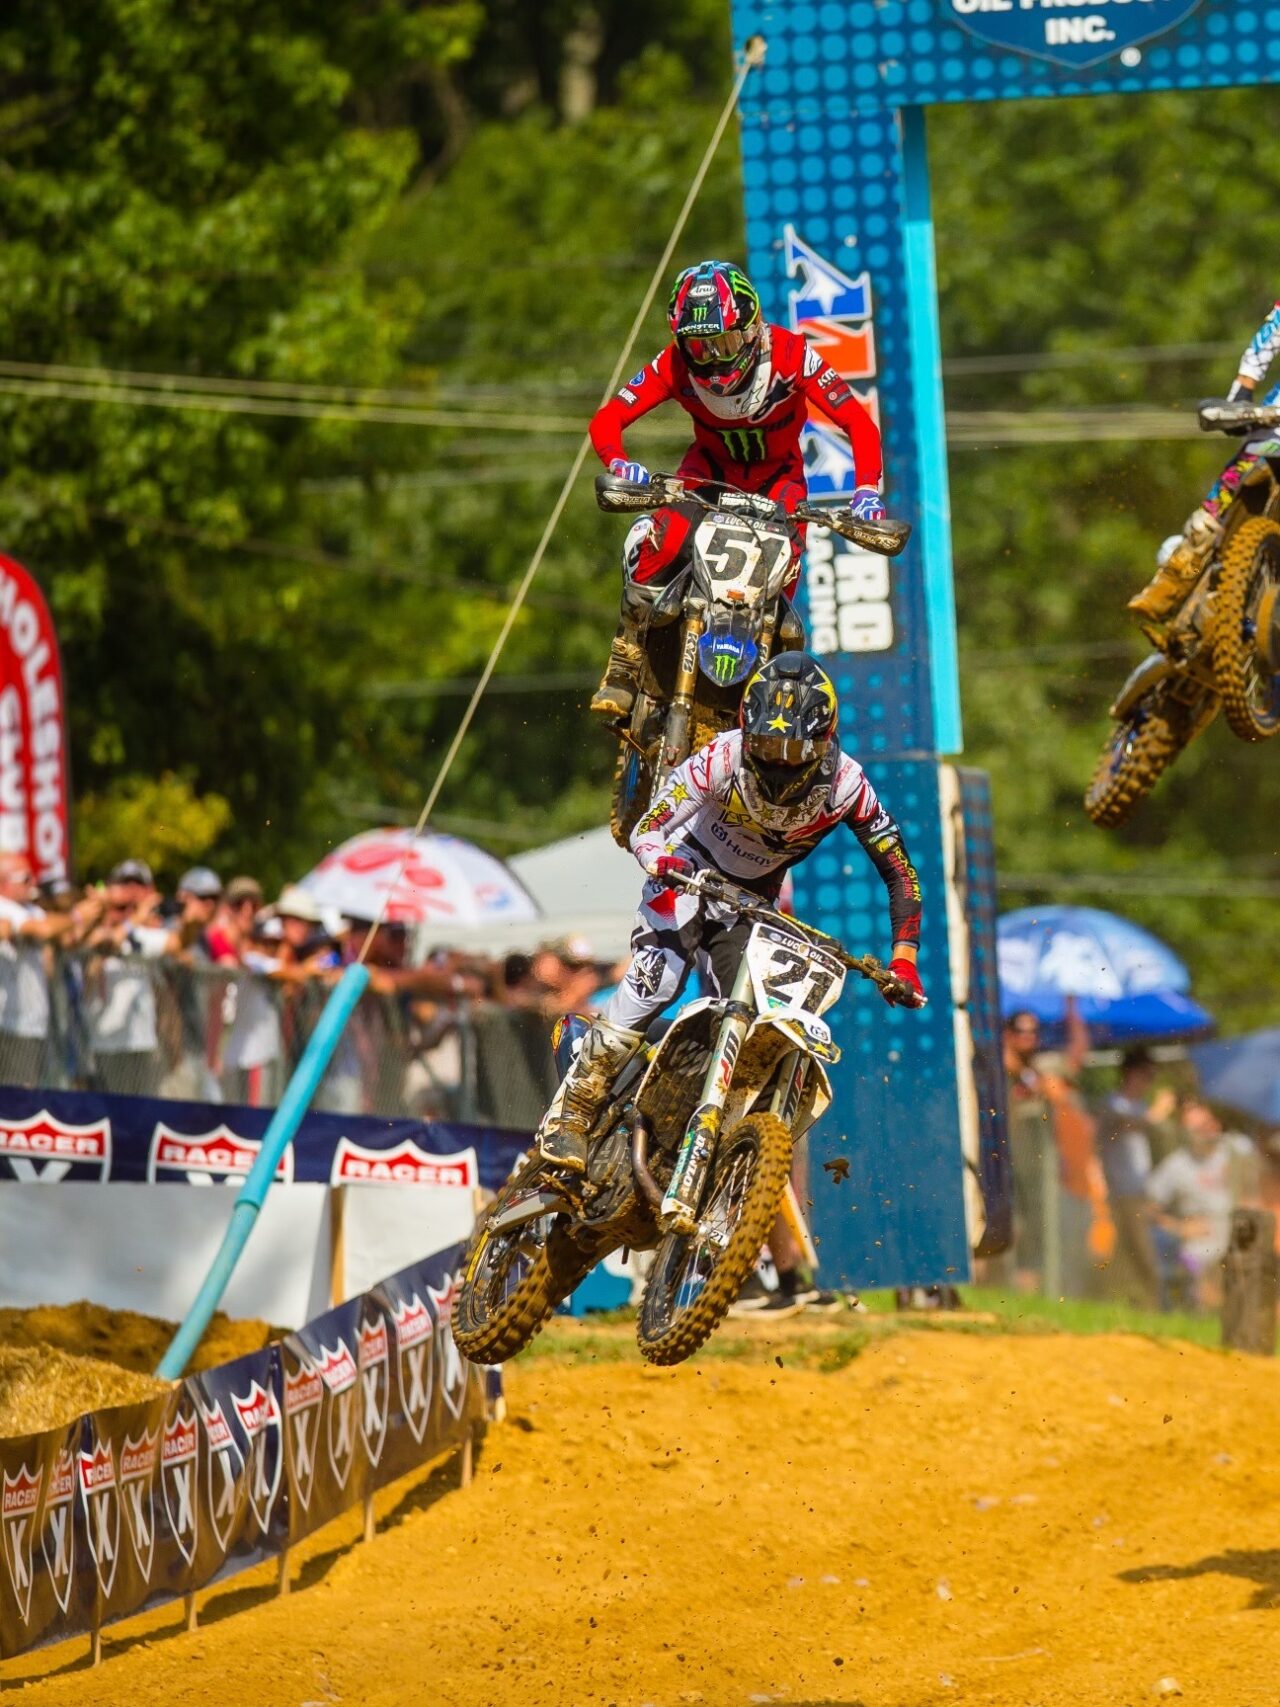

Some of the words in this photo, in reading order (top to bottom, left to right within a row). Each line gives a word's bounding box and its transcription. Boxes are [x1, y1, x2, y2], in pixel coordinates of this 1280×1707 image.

[1045, 16, 1116, 45] INC.
[753, 520, 767, 532] OIL
[705, 527, 785, 589] 51
[716, 643, 740, 654] YAMAHA
[809, 951, 824, 963] OIL
[761, 949, 836, 1015] 21
[161, 1143, 262, 1169] RACE
[345, 1159, 463, 1181] RACER
[710, 1230, 725, 1243] 21
